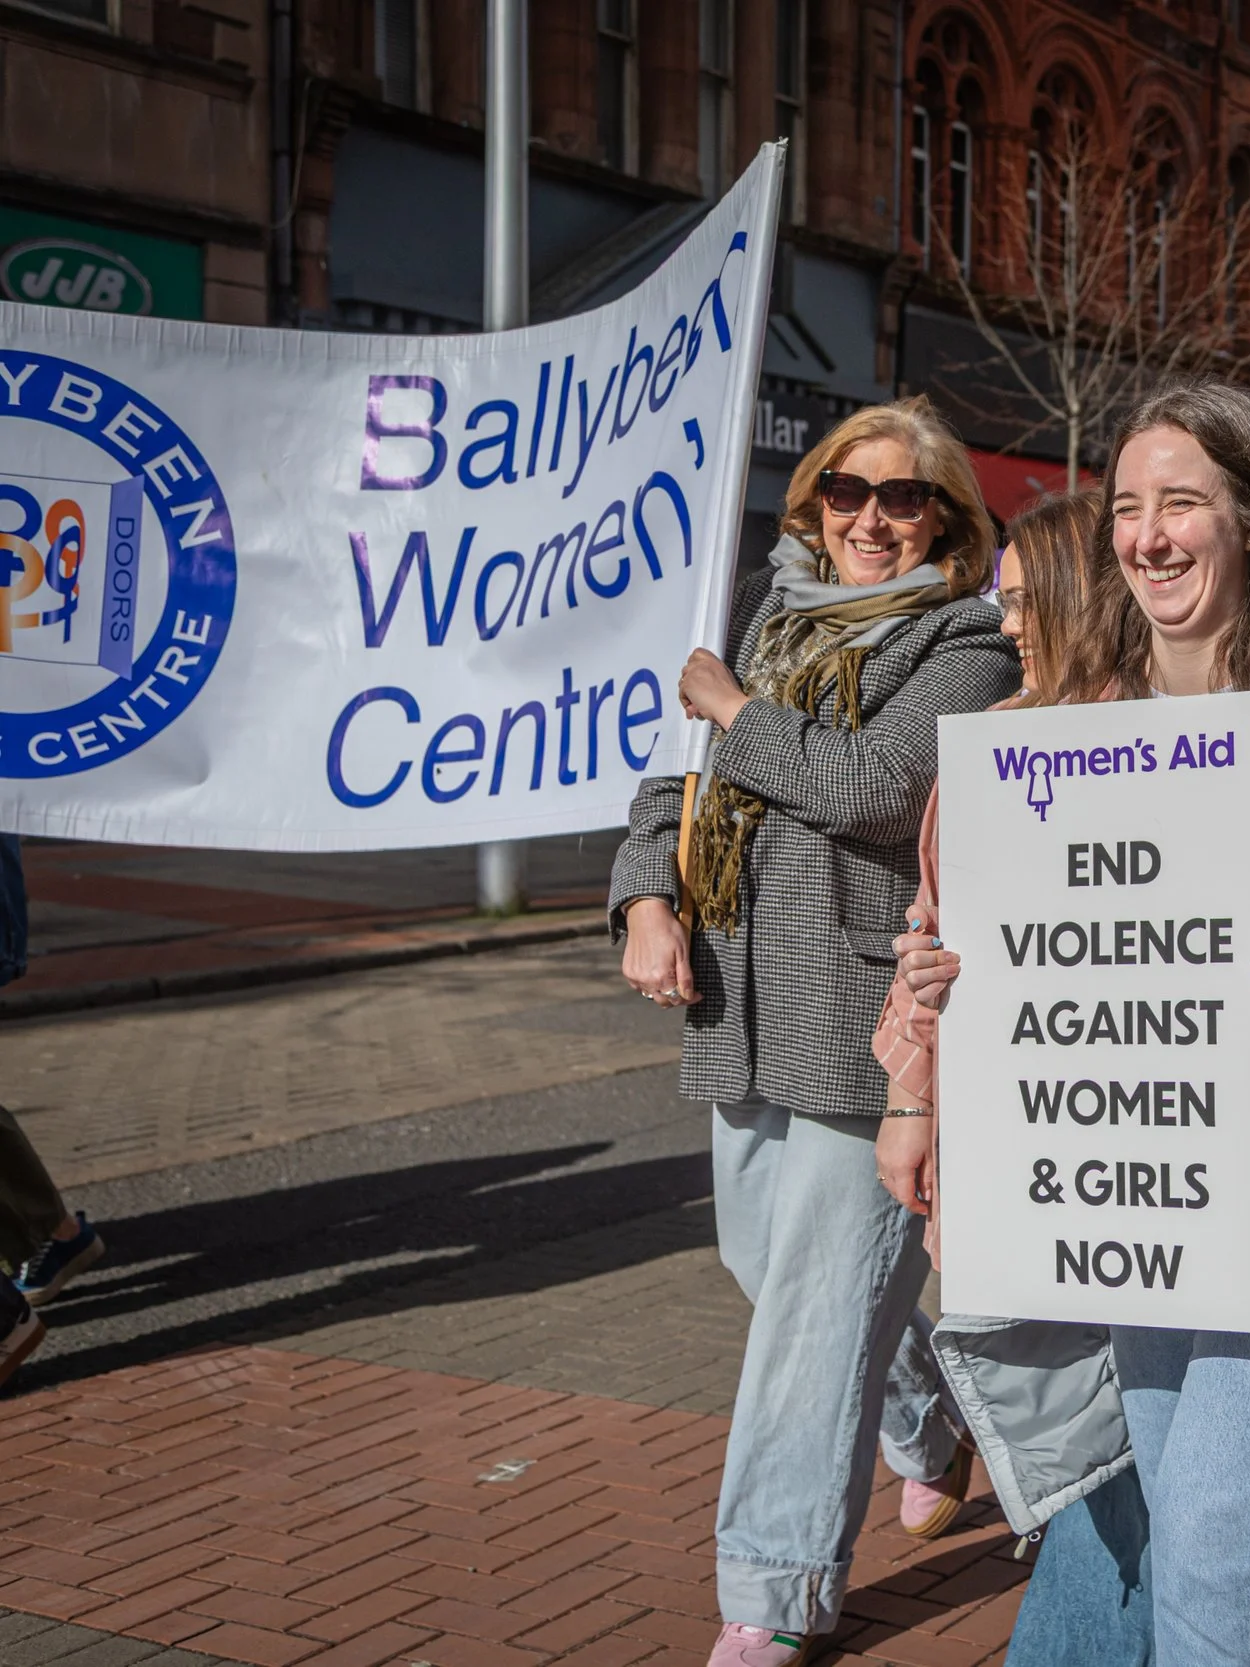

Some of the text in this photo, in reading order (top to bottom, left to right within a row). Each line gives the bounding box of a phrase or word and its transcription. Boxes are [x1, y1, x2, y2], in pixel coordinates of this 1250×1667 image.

[21, 257, 126, 310] JJB
[110, 517, 135, 643] DOORS
[27, 609, 212, 766] CENTRE
[326, 667, 661, 809] Centre
[993, 732, 1235, 821] Women's Aid
[1067, 840, 1161, 887] END
[1001, 917, 1234, 967] VIOLENCE
[1010, 999, 1224, 1046] AGAINST
[1018, 1080, 1216, 1127] WOMEN
[1028, 1158, 1210, 1210] & GIRLS
[1055, 1239, 1184, 1290] NOW
